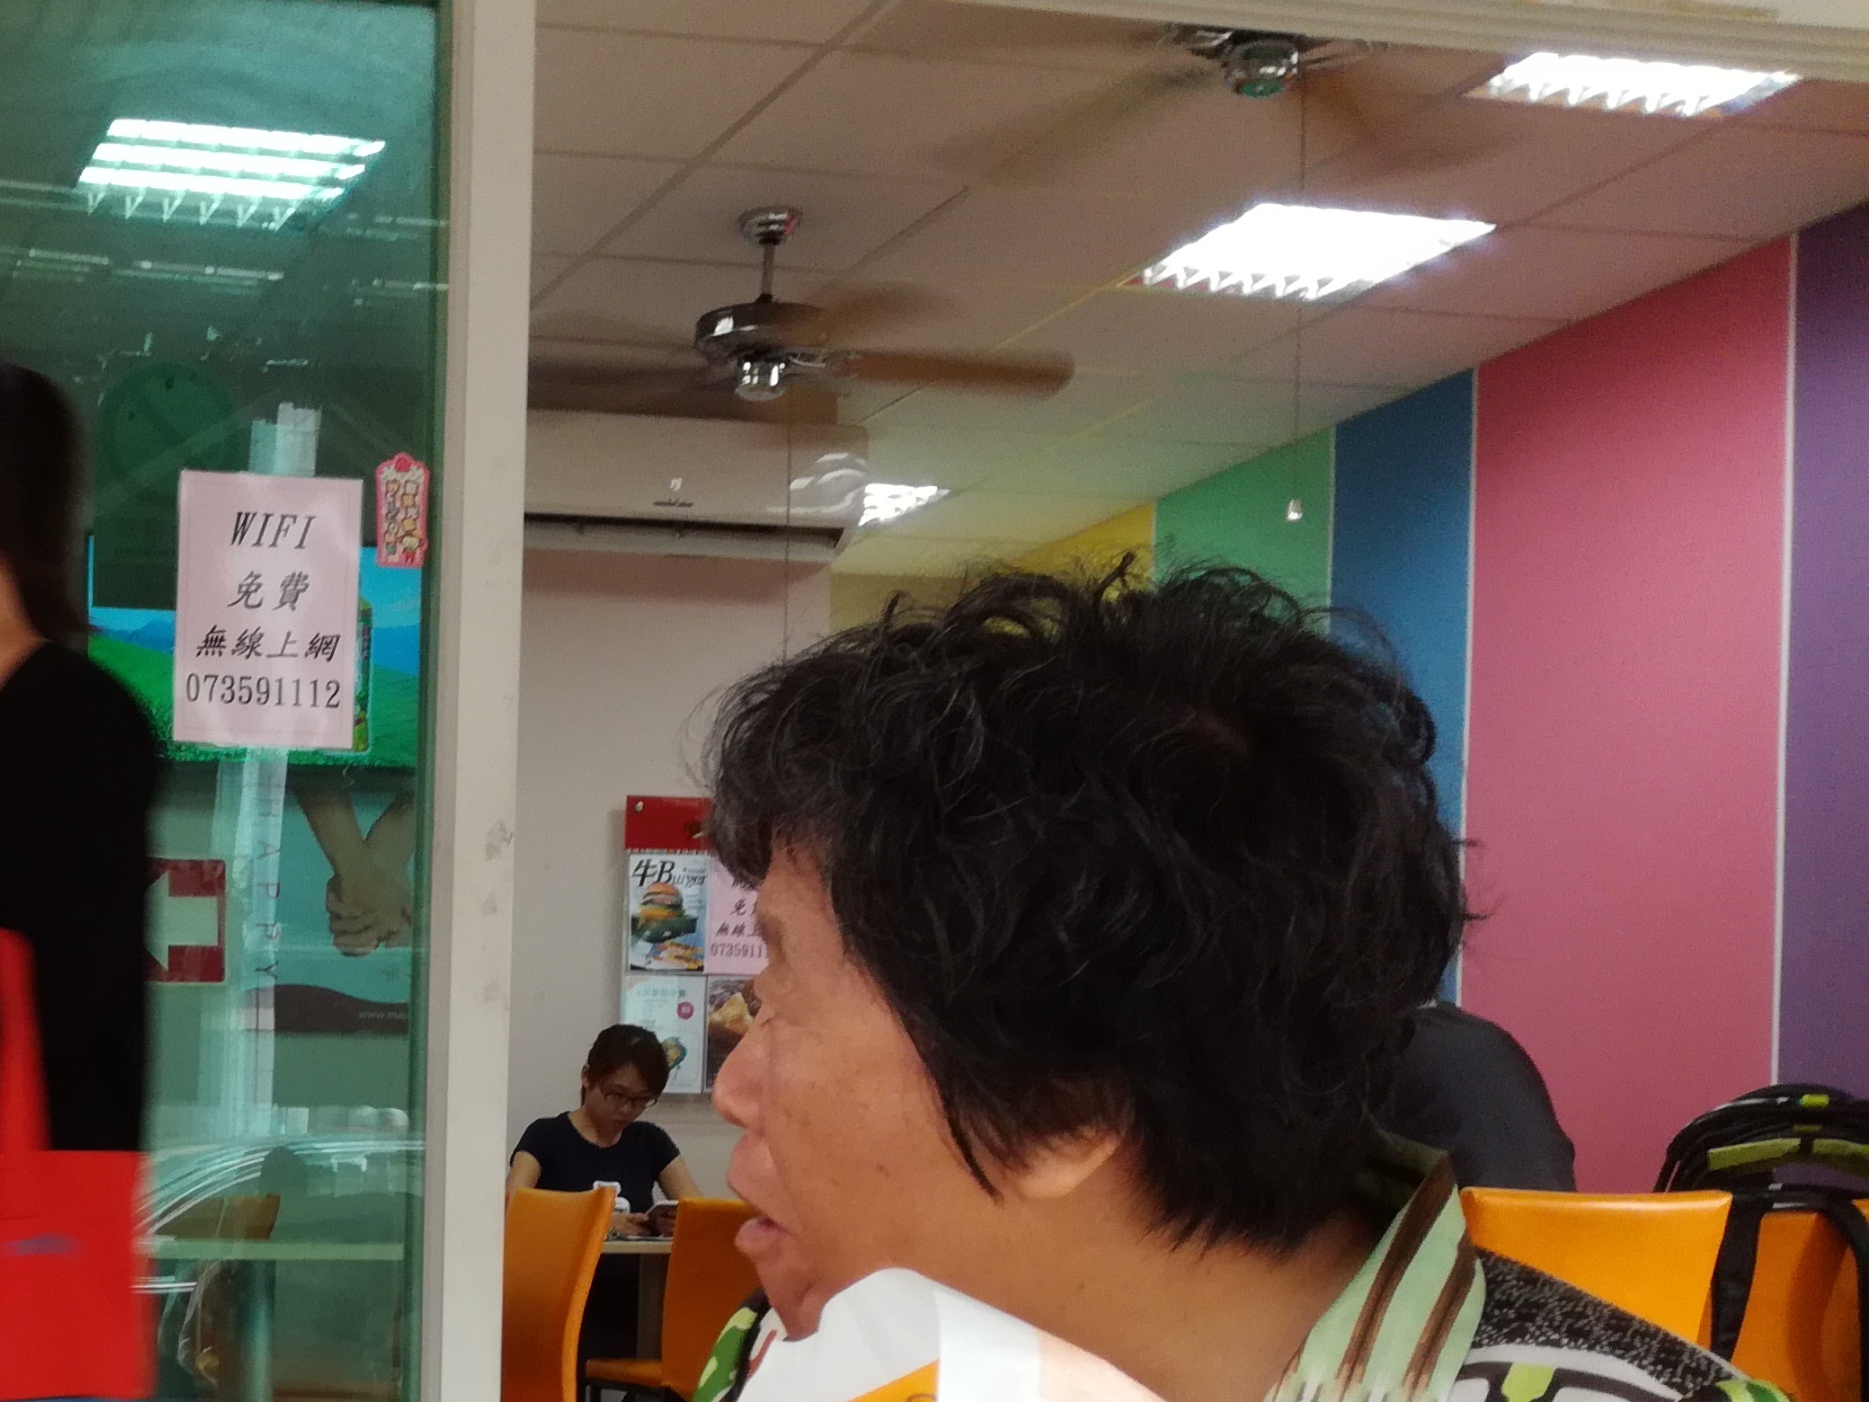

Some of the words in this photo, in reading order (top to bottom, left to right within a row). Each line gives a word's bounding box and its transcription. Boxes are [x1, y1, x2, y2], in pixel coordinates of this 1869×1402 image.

[230, 511, 317, 550] WIFI
[227, 570, 310, 612] 免費
[195, 624, 341, 662] 無線上網
[185, 673, 342, 709] 073591112
